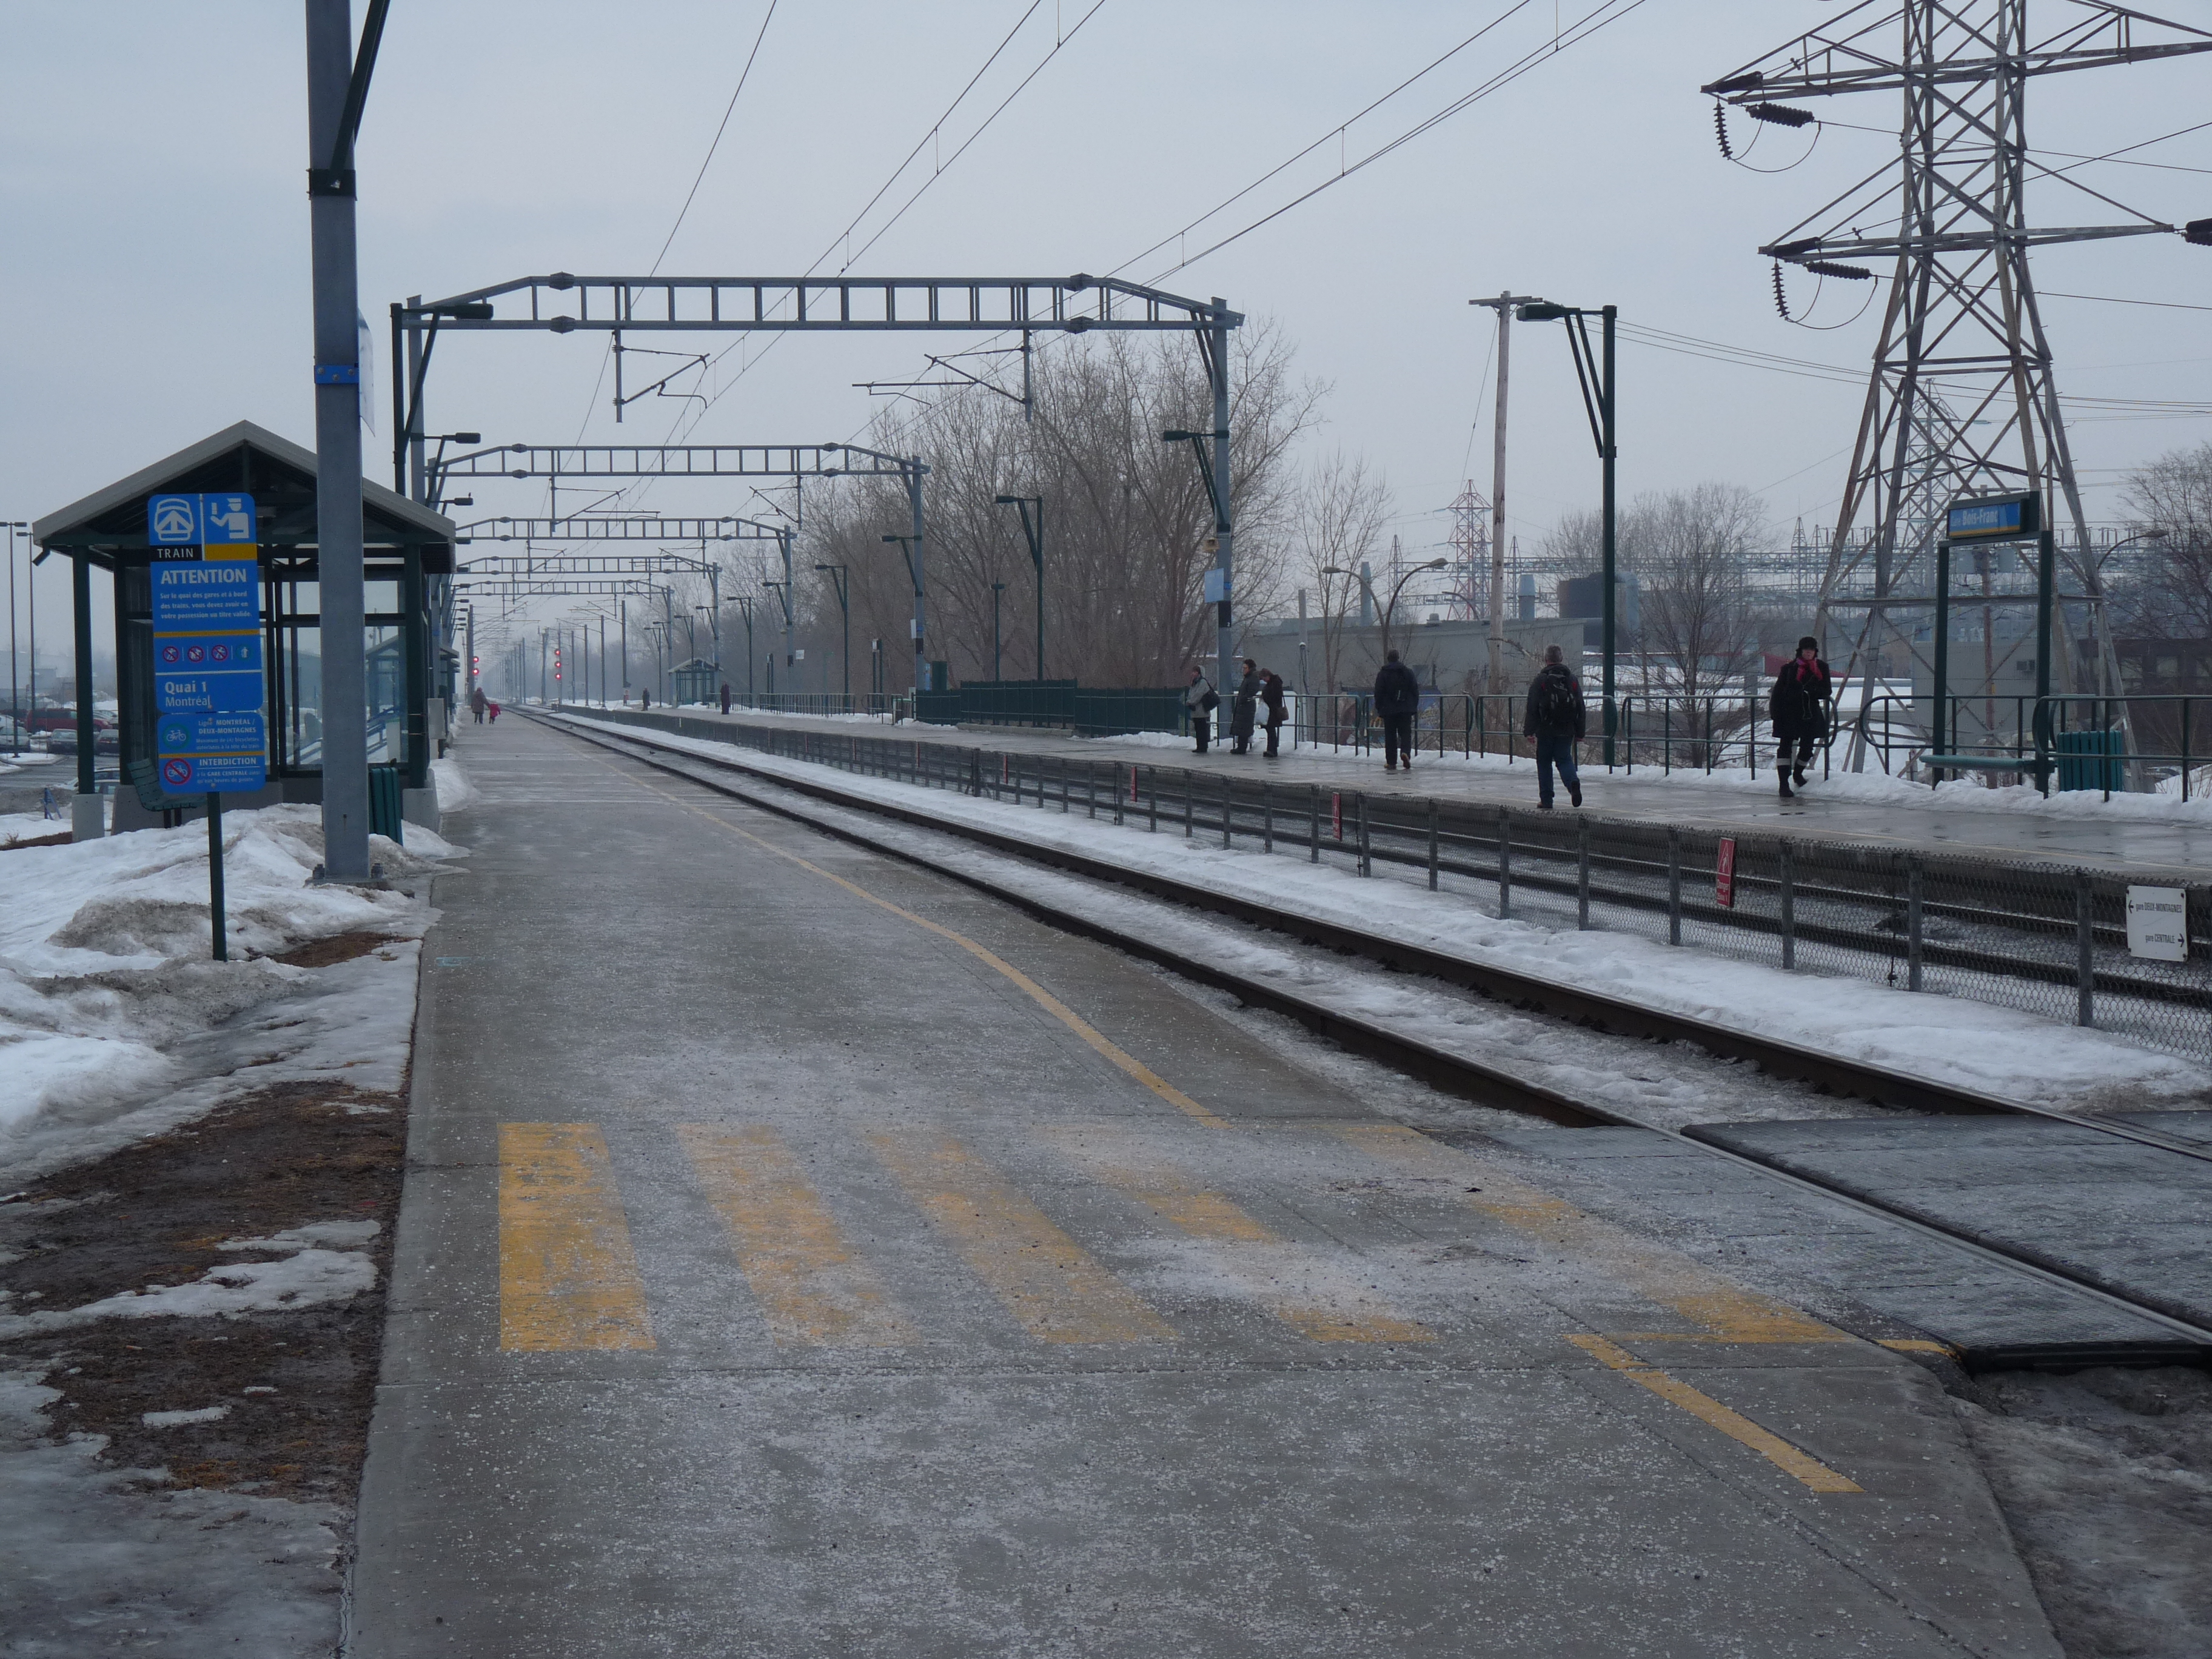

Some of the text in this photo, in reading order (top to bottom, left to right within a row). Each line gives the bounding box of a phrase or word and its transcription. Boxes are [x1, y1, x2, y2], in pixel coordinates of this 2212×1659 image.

[1962, 508, 1998, 526] Bois-Franc
[157, 548, 193, 558] TRAIN
[161, 568, 246, 585] ATTENTION
[165, 680, 206, 695] Quai 1
[166, 695, 210, 707] Montréal
[199, 757, 256, 766] INTERDICTION
[2136, 902, 2182, 913] gare DEUX-MONTAGNES
[2154, 934, 2175, 943] CENTRALE
